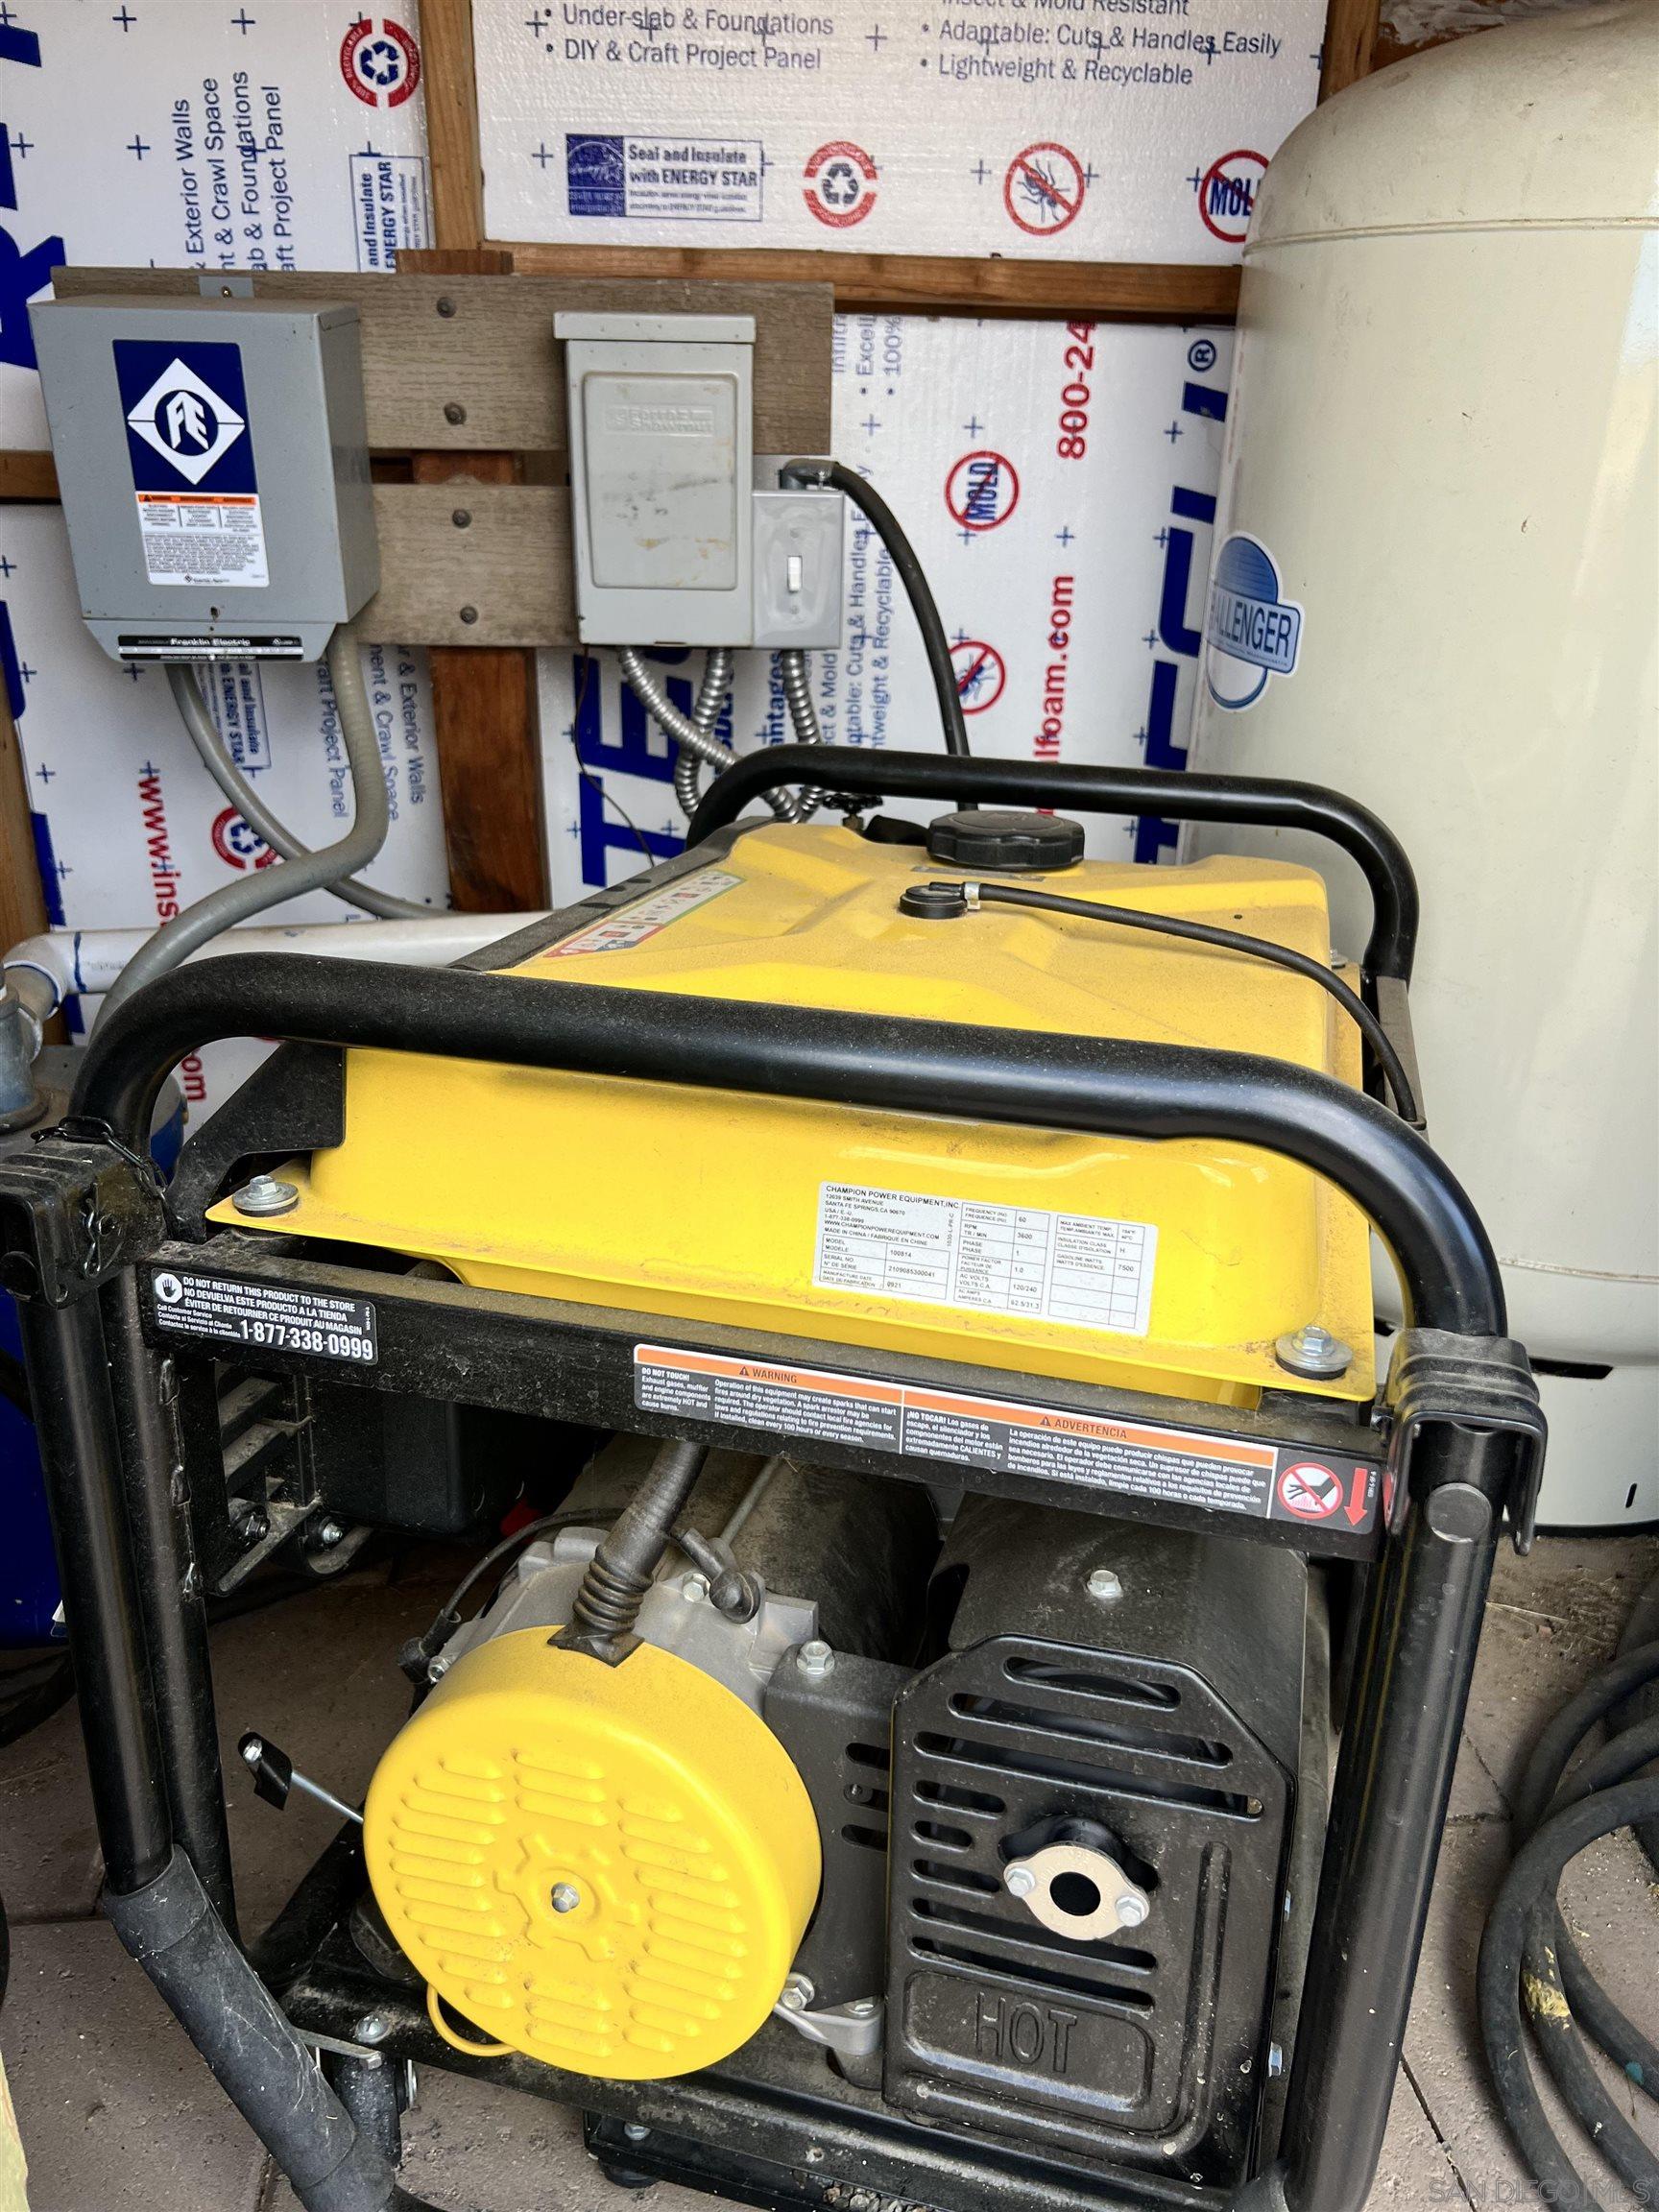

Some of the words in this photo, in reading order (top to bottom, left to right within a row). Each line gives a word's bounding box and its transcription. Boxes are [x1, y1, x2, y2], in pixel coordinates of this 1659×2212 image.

[683, 9, 698, 30] &
[706, 10, 834, 35] Foundations
[939, 19, 1050, 45] Adaptable:
[1057, 24, 1103, 48] Cuts
[1110, 25, 1124, 47] &
[1133, 28, 1215, 53] Handles
[1223, 32, 1282, 59] Easily
[565, 39, 599, 61] DIY
[606, 41, 621, 61] &
[629, 40, 680, 64] Craft
[686, 43, 757, 70] Project
[764, 47, 821, 69] Panel
[939, 54, 1055, 82] Lightweight
[1062, 60, 1076, 81] &
[1085, 60, 1192, 86] Recyclable
[172, 98, 193, 161] Walls
[203, 78, 226, 152] Space
[261, 84, 283, 151] Panel
[231, 71, 259, 215] Foundations
[629, 145, 661, 162] Seal
[664, 146, 688, 163] and
[691, 146, 747, 164] Insulate
[207, 158, 230, 221] Crawl
[379, 160, 396, 202] STAR
[630, 168, 660, 183] with
[662, 168, 716, 186] ENERGY
[722, 170, 757, 187] STAR
[180, 168, 204, 253] Exterior
[269, 157, 293, 237] Project
[360, 173, 377, 235] Insulate
[1209, 178, 1261, 216] MOL
[214, 228, 234, 246] &
[243, 223, 261, 240] &
[365, 236, 379, 267] and
[1057, 321, 1096, 460] 800-24
[965, 462, 1000, 521] MOLD
[848, 614, 863, 629] &
[170, 637, 210, 646] Franklin
[212, 637, 251, 646] Electric
[820, 653, 837, 698] Mold
[875, 657, 889, 670] &
[374, 690, 392, 706] &
[821, 705, 836, 718] &
[319, 698, 342, 761] Project
[399, 683, 421, 753] Exterior
[329, 767, 349, 818] Panel
[408, 757, 426, 805] Walls
[826, 1185, 866, 1196] CHAMPION
[868, 1190, 897, 1200] POWER
[182, 1276, 194, 1286] DO
[195, 1278, 210, 1288] NOT
[211, 1281, 242, 1293] RETURN
[244, 1286, 261, 1297] THIS
[262, 1288, 299, 1303] PRODUCT
[300, 1295, 311, 1305] TO
[313, 1297, 327, 1308] THE
[329, 1299, 355, 1311] STORE
[183, 1287, 195, 1297] NO
[196, 1289, 234, 1304] DEVUELVA
[236, 1296, 254, 1307] ESTE
[256, 1299, 298, 1314] PRODUCTO
[299, 1306, 305, 1315] A
[306, 1307, 317, 1317] LA
[318, 1309, 347, 1322] TIENDA
[1012, 1284, 1037, 1292] 120/240
[184, 1296, 210, 1310] ÉVITER
[211, 1302, 222, 1311] DE
[223, 1304, 267, 1319] RETOURNER
[268, 1311, 278, 1321] CE
[279, 1313, 312, 1327] PRODUIT
[312, 1319, 325, 1329] AU
[325, 1321, 362, 1335] MAGASIN
[239, 1318, 373, 1361] 1-877-338-0999
[641, 1366, 651, 1375] DO
[652, 1368, 665, 1377] NOT
[666, 1371, 689, 1382] TOUCH!
[641, 1375, 664, 1384] Exhaust
[665, 1380, 685, 1389] gases,
[686, 1382, 709, 1392] muffler
[753, 1367, 797, 1383] WARNING
[714, 1379, 743, 1391] Operation
[752, 1384, 763, 1393] this
[764, 1387, 796, 1400] equipment
[798, 1393, 810, 1403] may
[812, 1395, 830, 1405] create
[831, 1398, 854, 1409] sparks
[854, 1402, 867, 1410] that
[880, 1407, 896, 1415] start
[1054, 1418, 1127, 1439] ADVERTENCIA
[974, 1991, 1077, 2074] HOT
